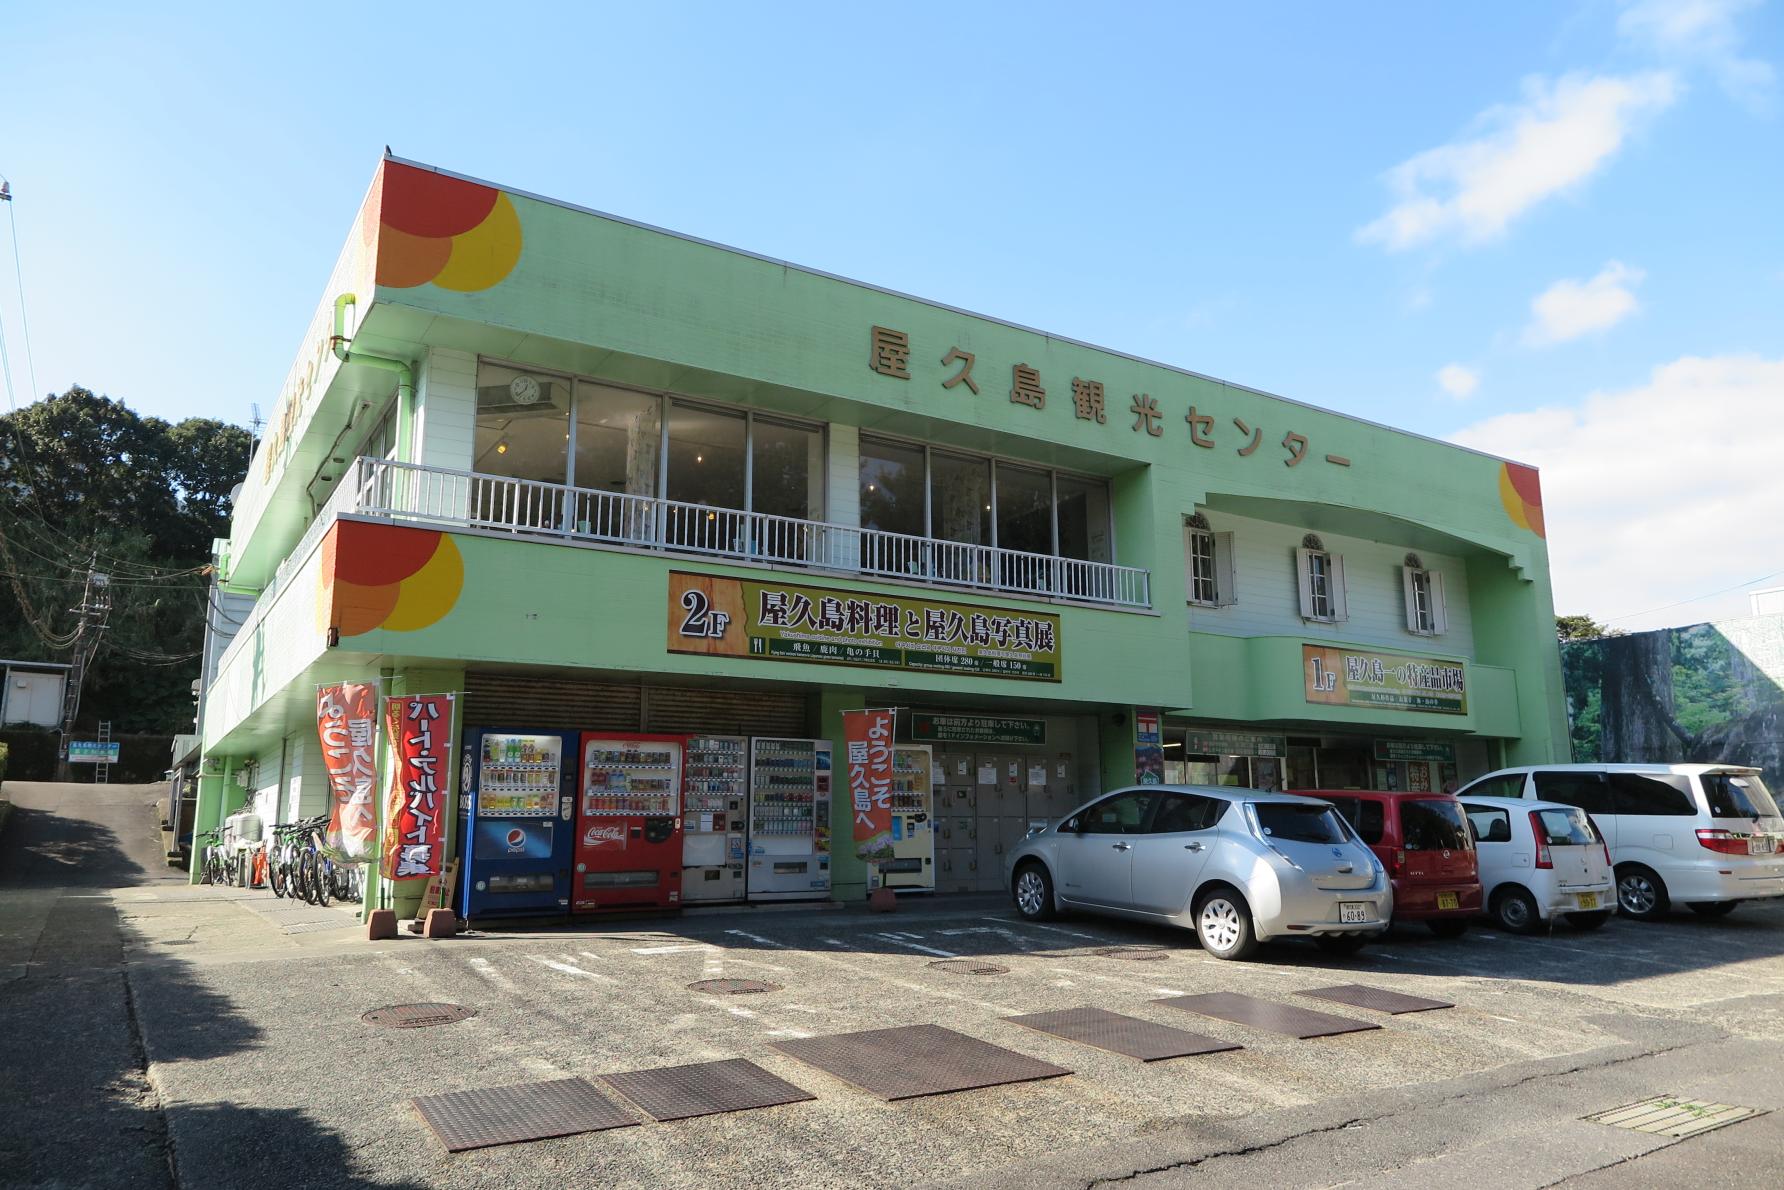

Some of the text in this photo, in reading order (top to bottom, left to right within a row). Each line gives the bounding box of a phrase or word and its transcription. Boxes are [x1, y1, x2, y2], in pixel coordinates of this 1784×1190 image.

[870, 325, 1350, 467] 屋久島観光センター
[680, 589, 729, 638] 2F
[758, 590, 1056, 653] 屋久島料理と屋久島写真展
[1312, 656, 1336, 692] 1F
[1345, 656, 1464, 693] 屋久島一の特産品市場
[847, 740, 876, 830] 屋久島へ
[868, 716, 891, 810] ようこそ
